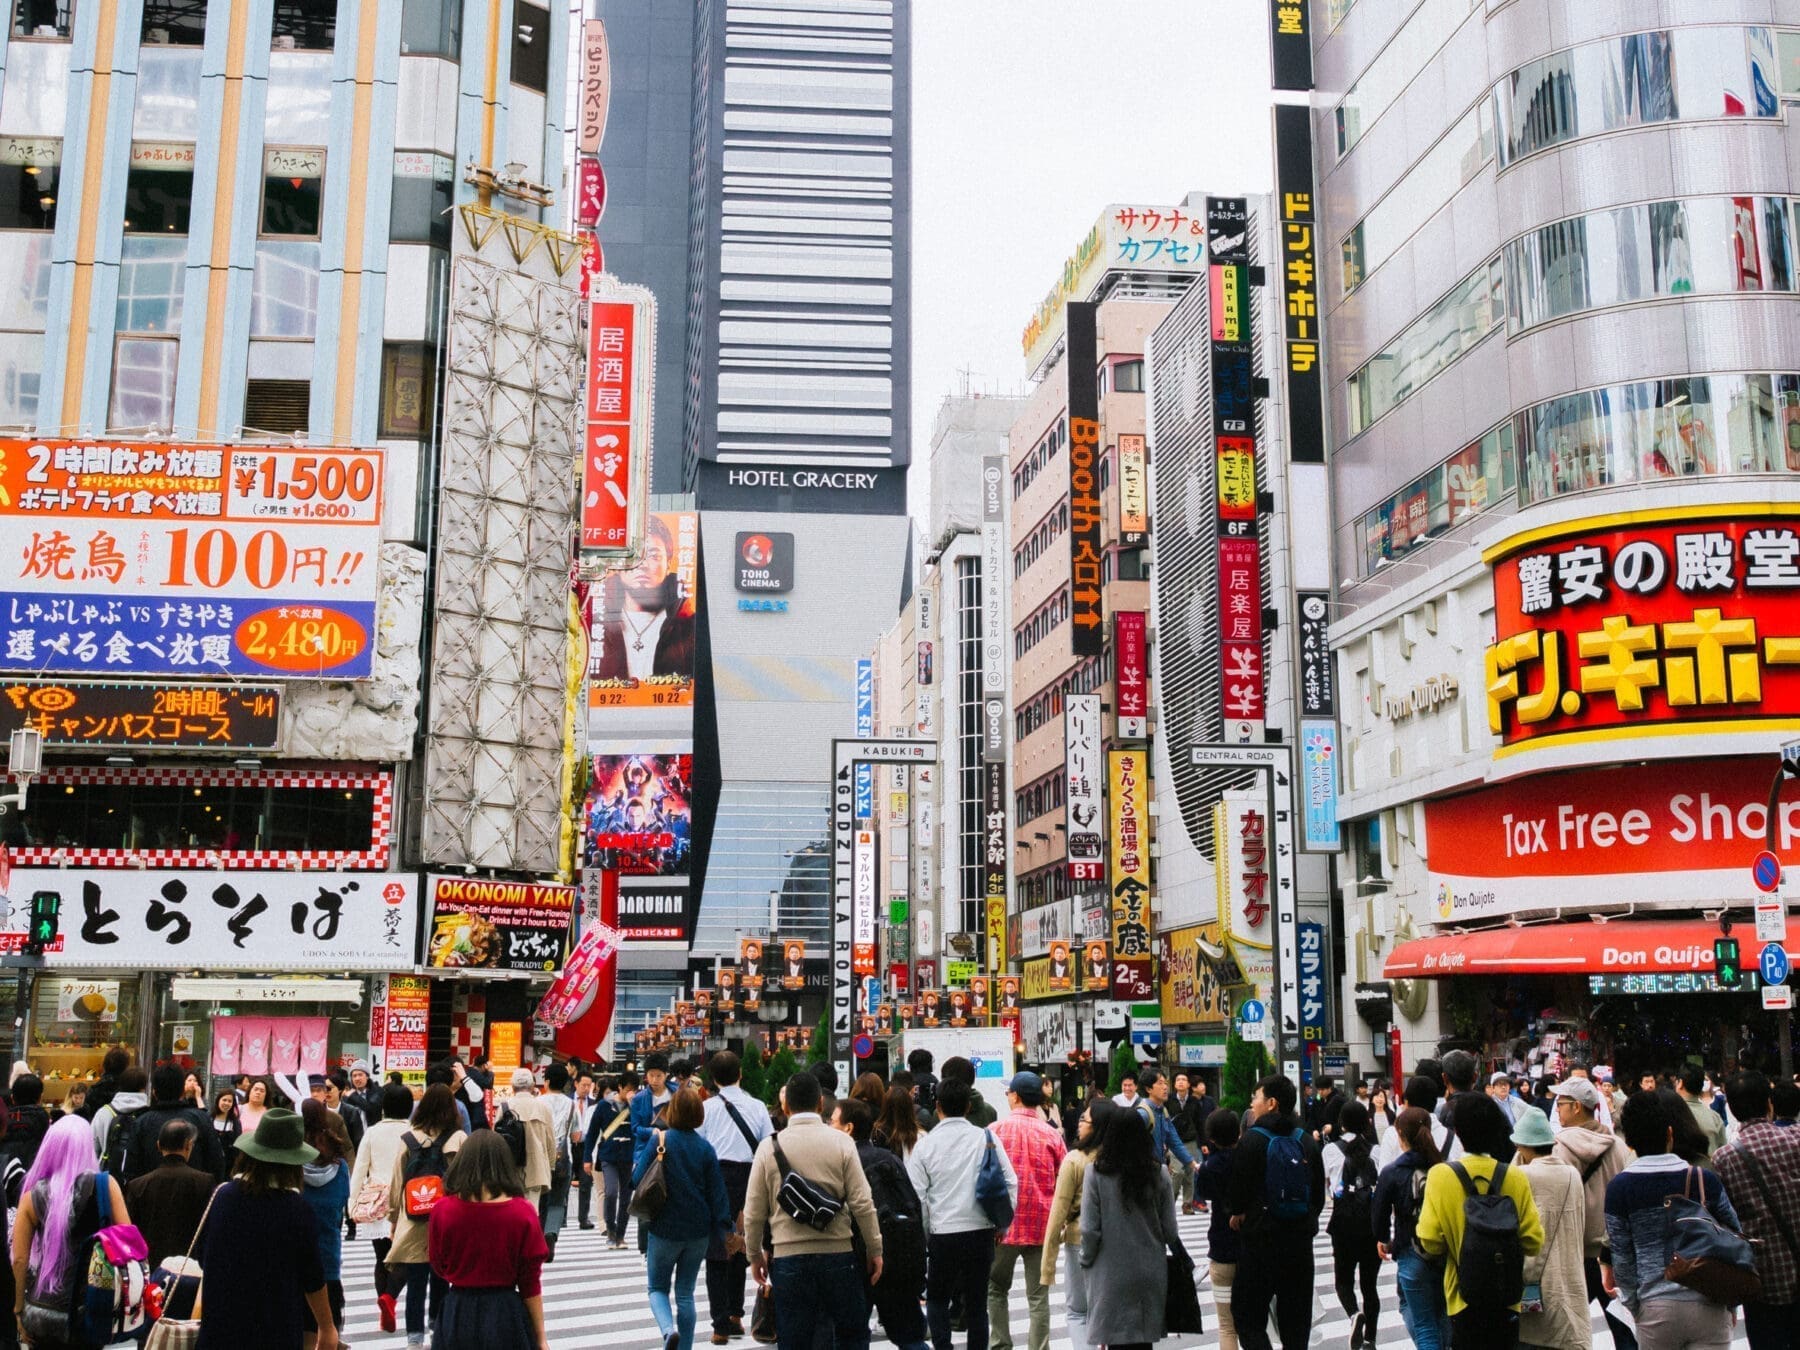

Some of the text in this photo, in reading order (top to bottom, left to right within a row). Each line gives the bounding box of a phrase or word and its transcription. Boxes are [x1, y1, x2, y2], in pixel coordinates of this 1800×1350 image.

[1277, 0, 1304, 34] 堂
[595, 327, 625, 414] 居酒屋
[26, 445, 223, 483] 2時間飲み放題
[1070, 416, 1102, 533] Booth
[234, 456, 374, 502] ¥1,500
[729, 470, 878, 489] HOTEL GRACERY
[18, 488, 222, 516] ポテトフライ食べ放題
[1126, 532, 1142, 543] 6F
[1228, 522, 1249, 535] 6F
[19, 529, 129, 585] 焼鳥
[160, 528, 364, 590] 100円!!
[1518, 528, 1800, 614] 驚安の殿堂
[741, 579, 780, 588] CINEMAS
[742, 569, 770, 579] TOHO
[10, 598, 234, 629] しゃぶしゃぶ VS すきやき
[278, 607, 323, 620] 食べ放題
[737, 599, 789, 613] IMAX
[1229, 570, 1252, 638] 居楽屋
[6, 630, 233, 666] 選べる食べ放題
[247, 619, 358, 660] 2,480円
[1386, 676, 1460, 721] Don Quijote
[33, 711, 232, 741] キャンパスコース
[1196, 751, 1274, 761] CENTRAL ROAD
[1121, 756, 1139, 852] きんくら酒場
[1503, 814, 1549, 858] Tax
[1558, 804, 1652, 851] Free
[989, 873, 1004, 883] 4F
[1074, 864, 1096, 879] B1
[1240, 809, 1270, 929] カラオケ
[438, 880, 575, 907] OKONOMI YAKI
[835, 785, 850, 1008] GODZILLA ROAD
[988, 883, 1004, 894] 3F
[1453, 892, 1496, 910] Don Quijote
[81, 879, 360, 949] とらそば
[436, 902, 571, 920] All-You-Can-Eat dinner with Free-Flowing
[489, 915, 511, 925] Drinks
[511, 917, 521, 925] for
[528, 918, 547, 927] hours
[1114, 876, 1151, 957] 金の蔵
[510, 961, 544, 969] TORADYU
[1423, 951, 1466, 969] Don Quijote
[1602, 944, 1715, 967] Don Quijo
[1765, 953, 1777, 979] P
[1116, 963, 1140, 985] 2F
[1301, 928, 1322, 1022] カラオケ
[63, 983, 118, 995] カツカレー
[1304, 1026, 1323, 1041] B1
[219, 1038, 327, 1061] とらそば
